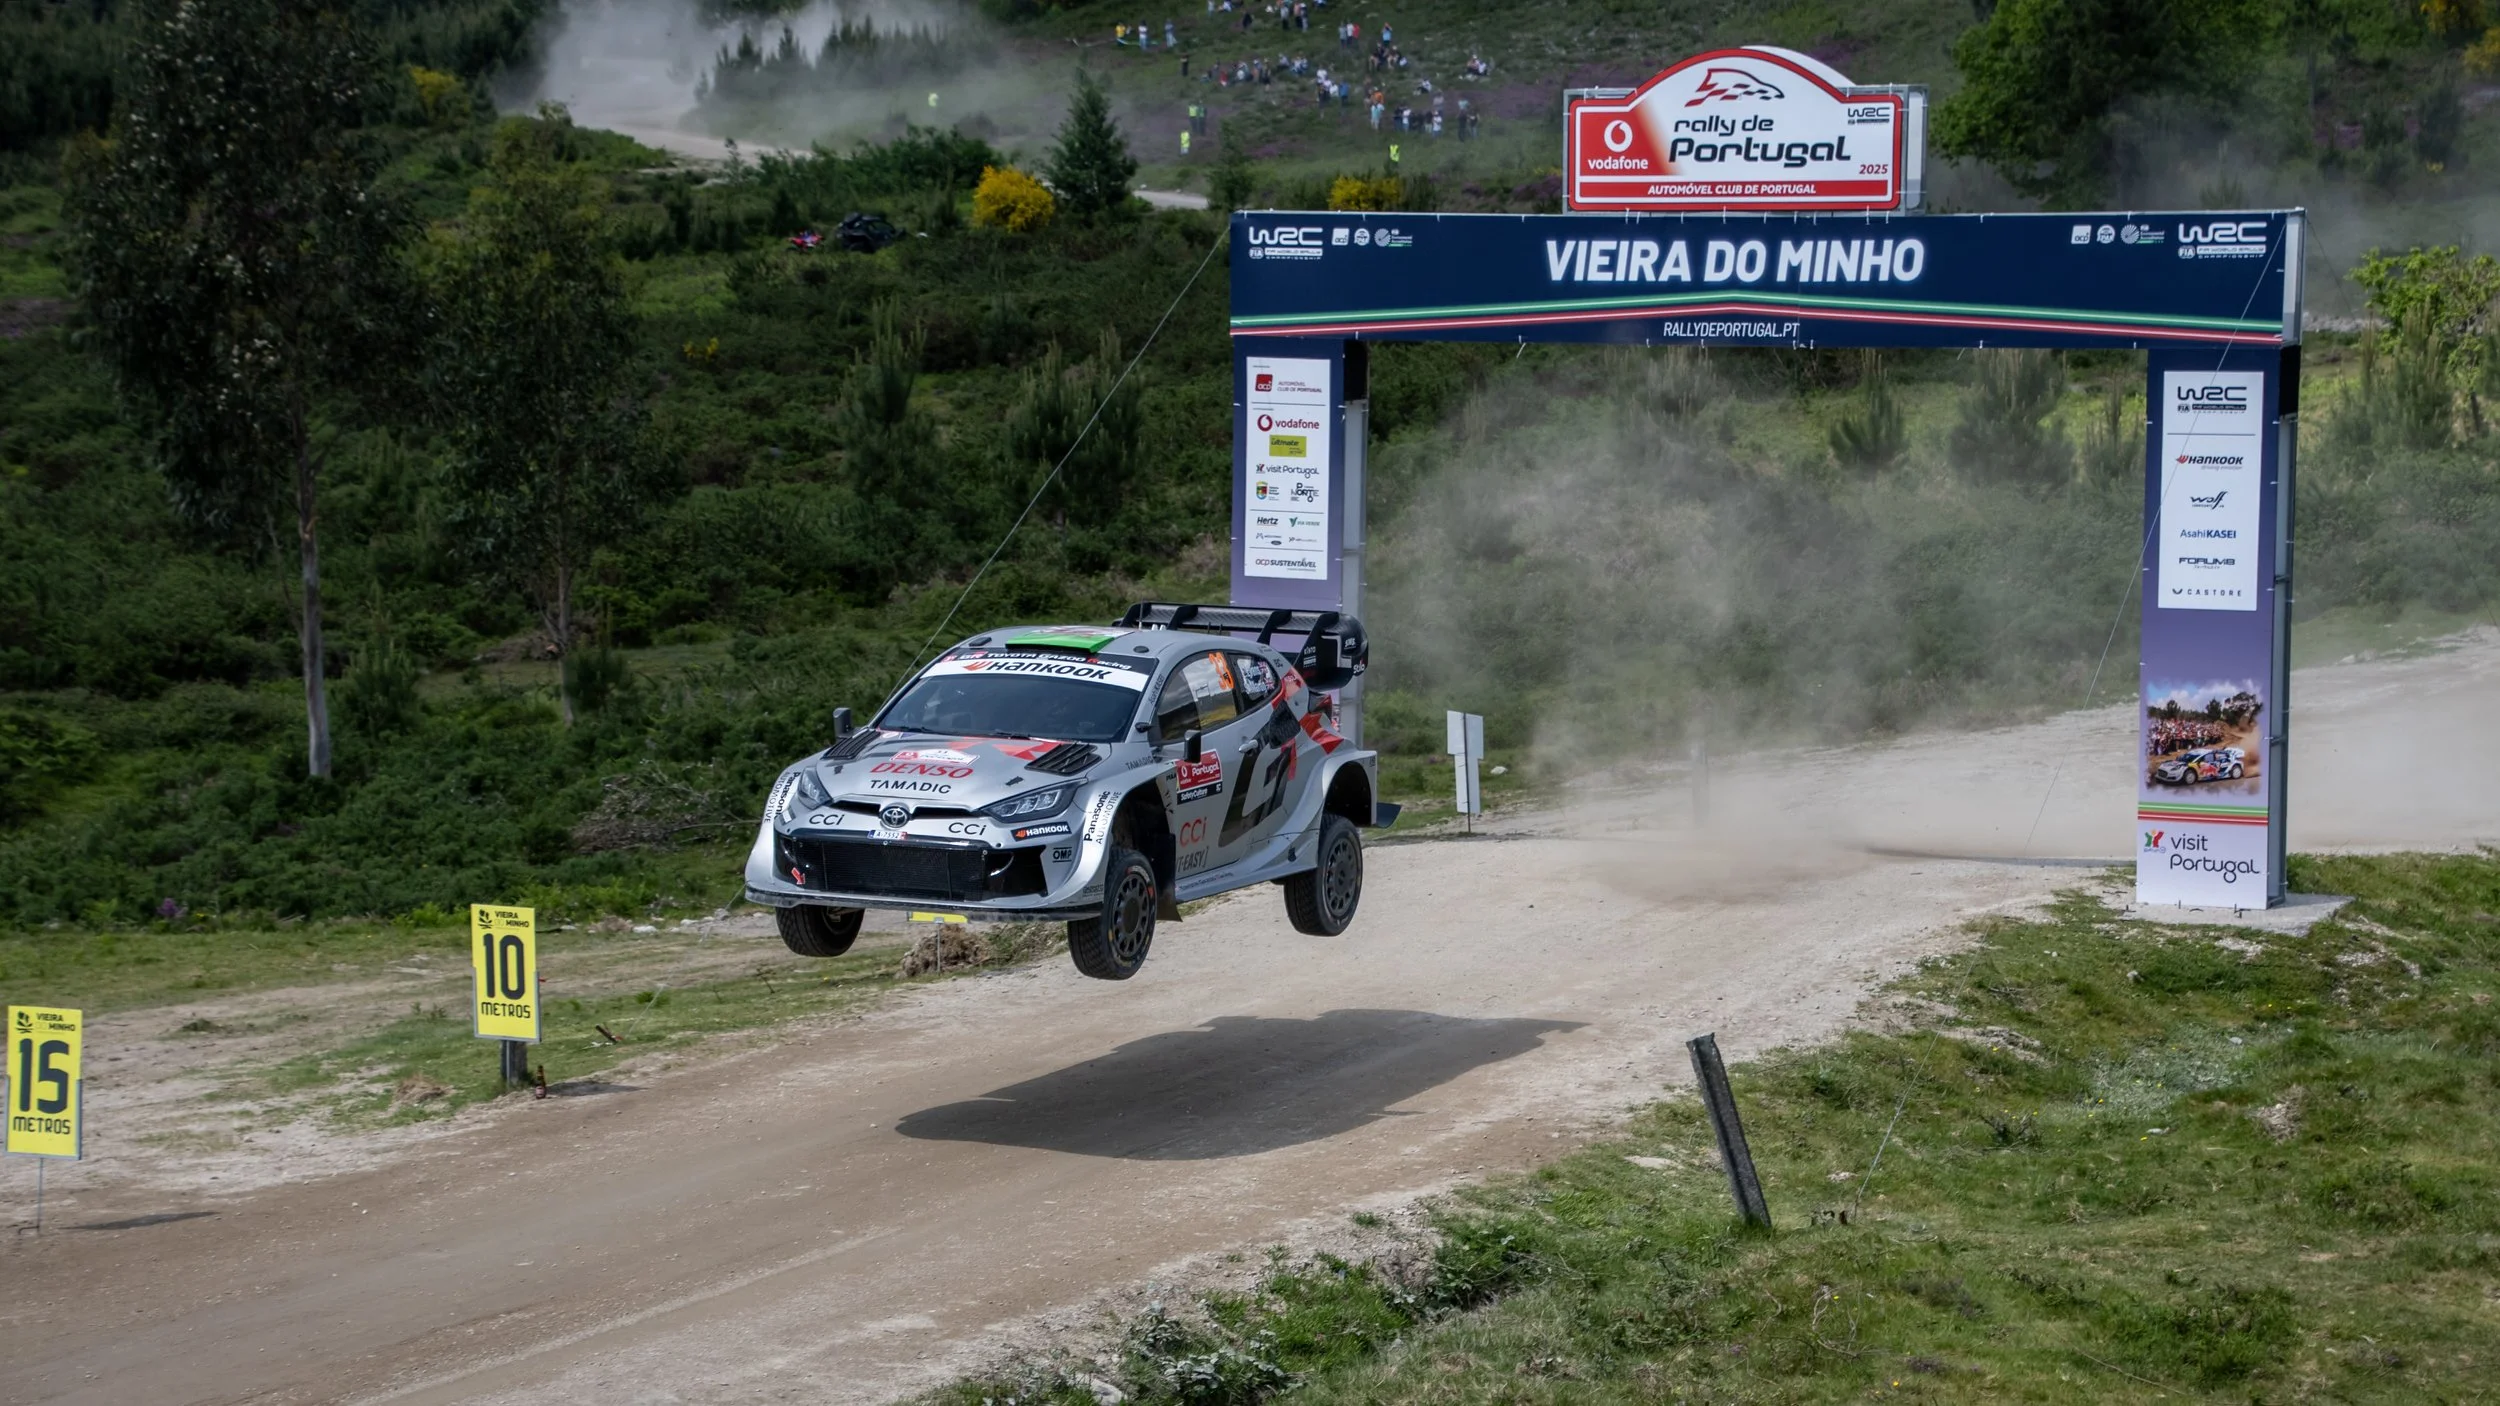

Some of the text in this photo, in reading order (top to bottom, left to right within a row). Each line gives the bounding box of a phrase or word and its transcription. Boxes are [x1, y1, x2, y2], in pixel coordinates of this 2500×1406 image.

[1847, 107, 1890, 118] WRC
[1674, 115, 1774, 137] rally de
[1668, 135, 1850, 168] Portugal
[1587, 156, 1649, 170] vodafone
[1858, 164, 1888, 175] 2025
[1647, 181, 1817, 196] AUTOMÓVEL CLUB DE PORTUGAL
[1249, 226, 1323, 246] WRC
[2178, 222, 2267, 243] WRC
[1546, 239, 1926, 283] VIEIRA DO MINHO
[1663, 321, 1799, 338] RALLYDEPORTUGAL.PT
[2177, 386, 2248, 401] WRC
[1275, 419, 1320, 429] vodafone
[1266, 464, 1320, 479] visit Portugal
[1257, 516, 1279, 525] Hertz
[1270, 558, 1316, 568] SUSTENTÁVEL
[2187, 588, 2242, 597] CASTORE
[1038, 653, 1086, 662] GAZOO
[1086, 657, 1132, 670] Racing
[870, 762, 974, 778] DENSO
[1192, 761, 1220, 777] Portugal
[870, 780, 951, 794] TAMADIC
[764, 771, 790, 822] AUTOMOTIVE
[808, 814, 846, 826] CCi
[1083, 790, 1111, 842] Panasonic
[1095, 791, 1122, 845] AUTOMOTIVE
[948, 822, 987, 836] CCi
[2170, 833, 2208, 851] visit
[1053, 850, 1072, 860] OMP
[2170, 853, 2260, 884] Portugal
[495, 910, 518, 919] VIEIRA
[506, 919, 530, 928] MINHO
[483, 933, 526, 1001] 10
[36, 1012, 64, 1022] VIEIRA
[481, 1002, 531, 1019] METROS
[48, 1022, 76, 1032] MINHO
[19, 1037, 70, 1115] 15
[13, 1116, 71, 1135] METROS
